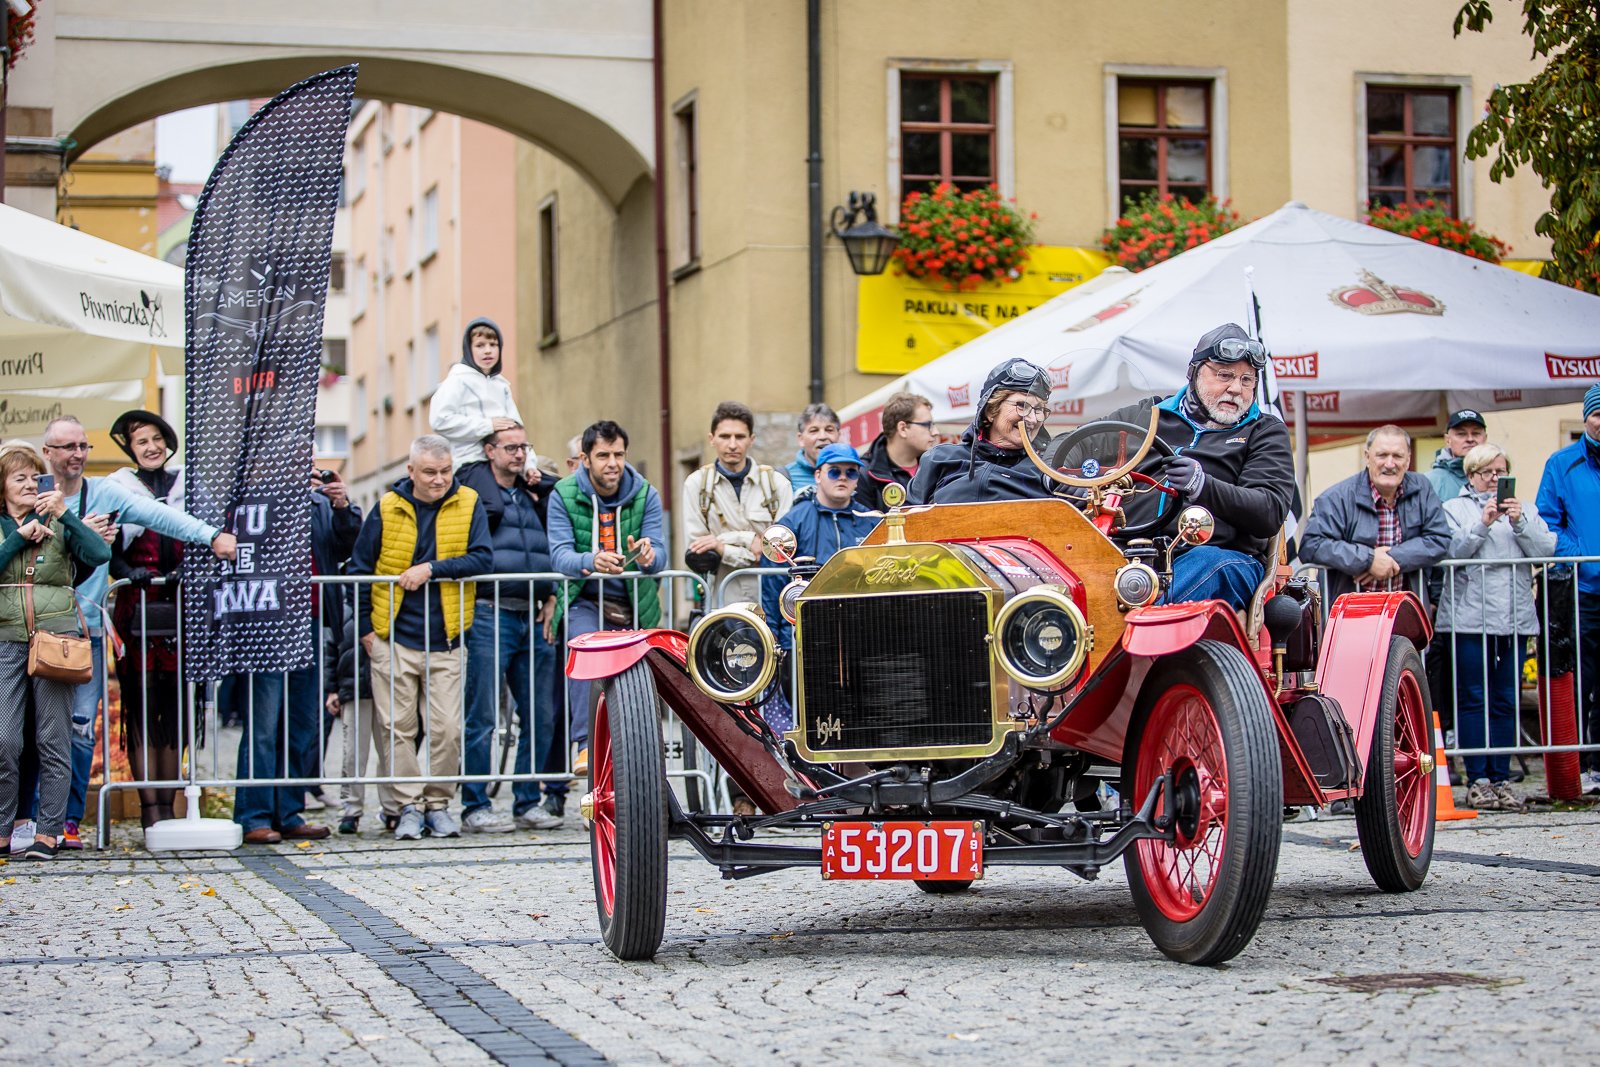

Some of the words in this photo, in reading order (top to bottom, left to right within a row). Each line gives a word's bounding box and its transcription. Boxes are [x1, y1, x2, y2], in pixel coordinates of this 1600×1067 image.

[80, 291, 150, 326] Piwniczka
[217, 284, 296, 309] AMECAN
[904, 299, 958, 316] PAKUJ
[964, 303, 989, 320] SIĘ
[996, 305, 1020, 319] NA
[1273, 356, 1316, 377] SKIE
[865, 555, 920, 585] Ford
[816, 713, 842, 745] 1914
[840, 828, 965, 873] 53207
